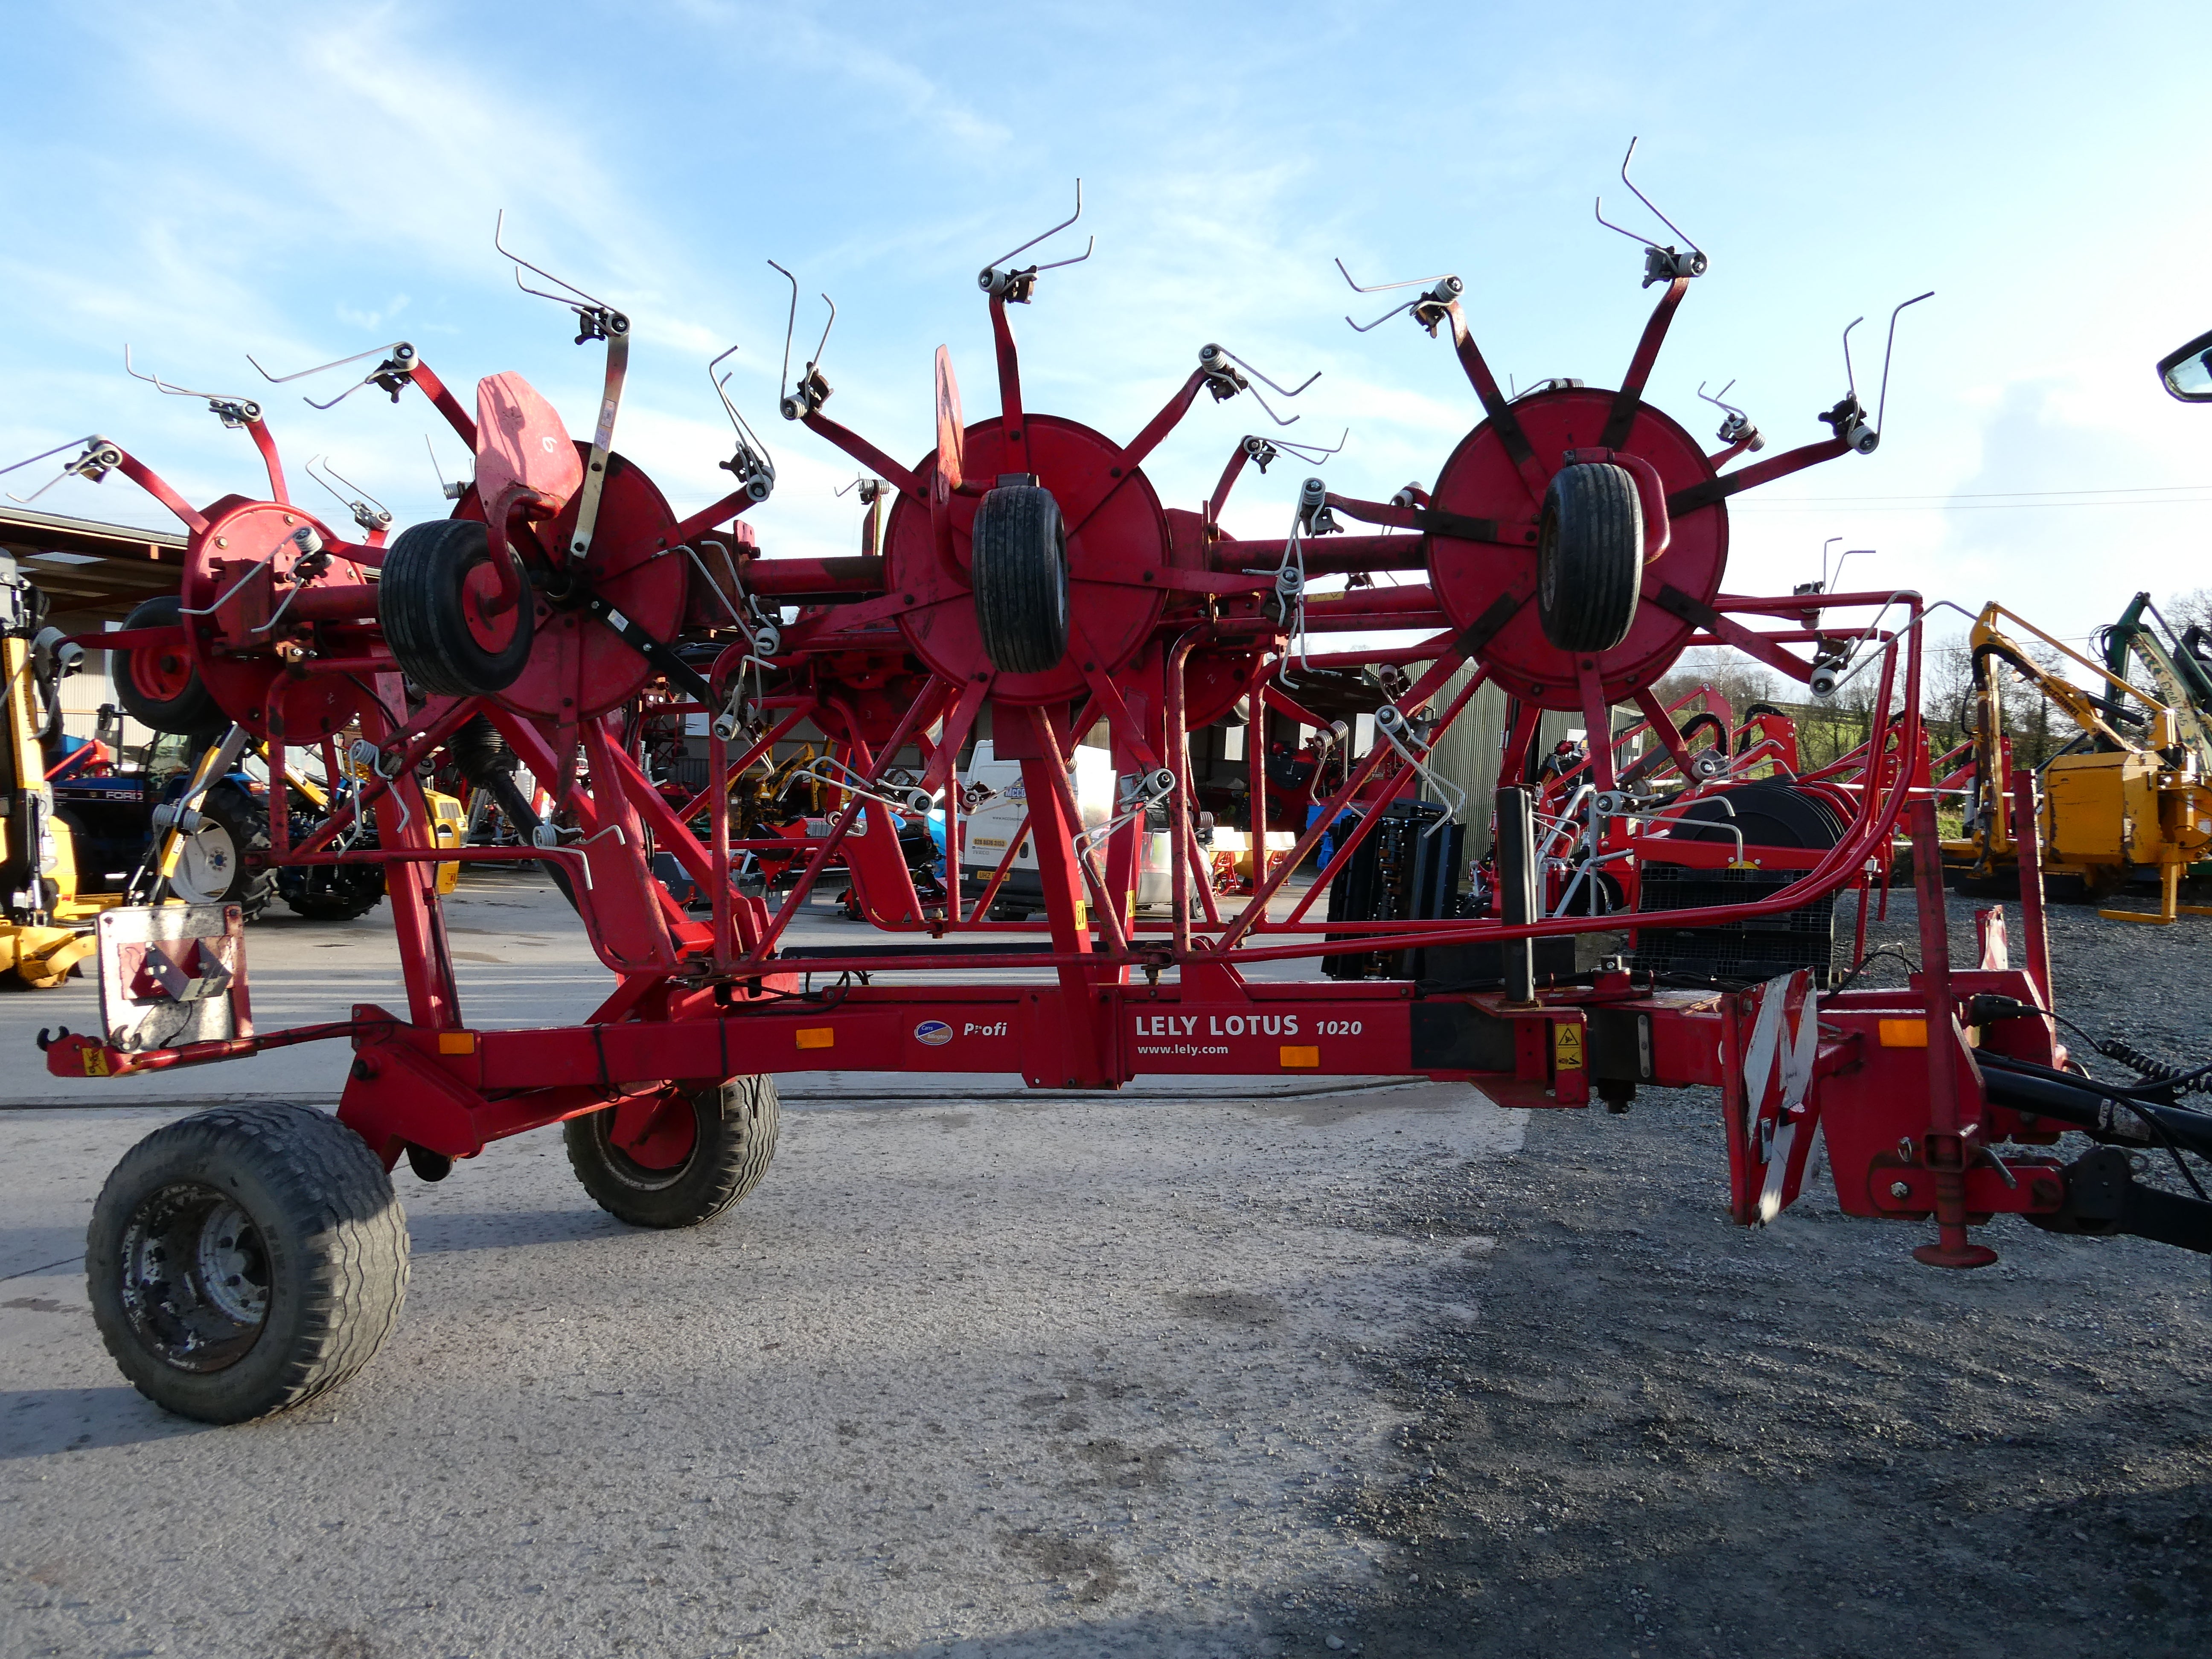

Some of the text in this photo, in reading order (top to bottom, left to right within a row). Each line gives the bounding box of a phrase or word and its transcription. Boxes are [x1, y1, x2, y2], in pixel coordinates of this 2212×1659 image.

[106, 792, 143, 800] FORD
[1005, 788, 1026, 797] MCCO
[1136, 1015, 1362, 1036] LELY LOTUS 1020
[1138, 1044, 1228, 1056] www.lely.com
